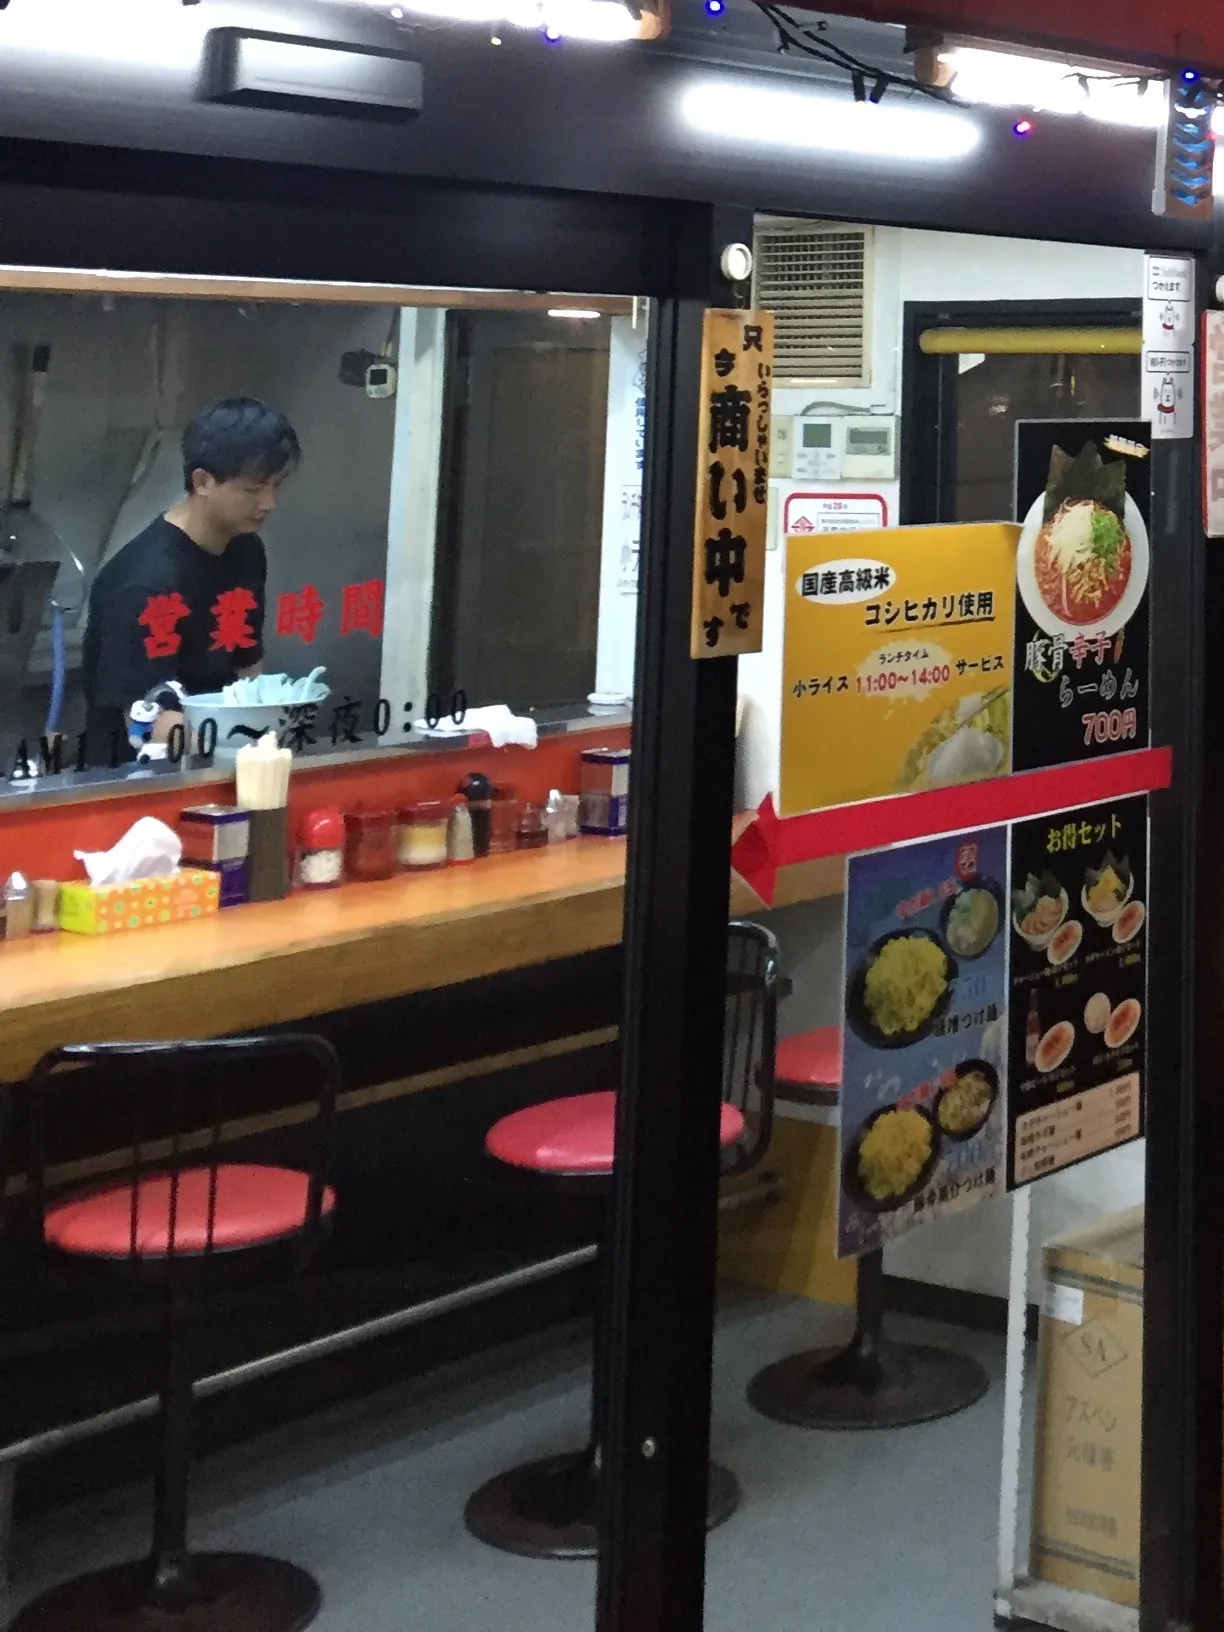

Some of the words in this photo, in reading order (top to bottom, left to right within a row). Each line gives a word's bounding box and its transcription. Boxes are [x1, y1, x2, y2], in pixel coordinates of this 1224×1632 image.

[802, 566, 890, 597] 国産高級米
[138, 579, 386, 659] 営業時間
[864, 590, 994, 626] コシヒカリ使用
[878, 648, 930, 665] ランチタイム
[793, 675, 849, 699] 小ライス
[955, 655, 1005, 676] サービス
[1081, 706, 1137, 746] 700円
[1046, 814, 1122, 854] お得セット
